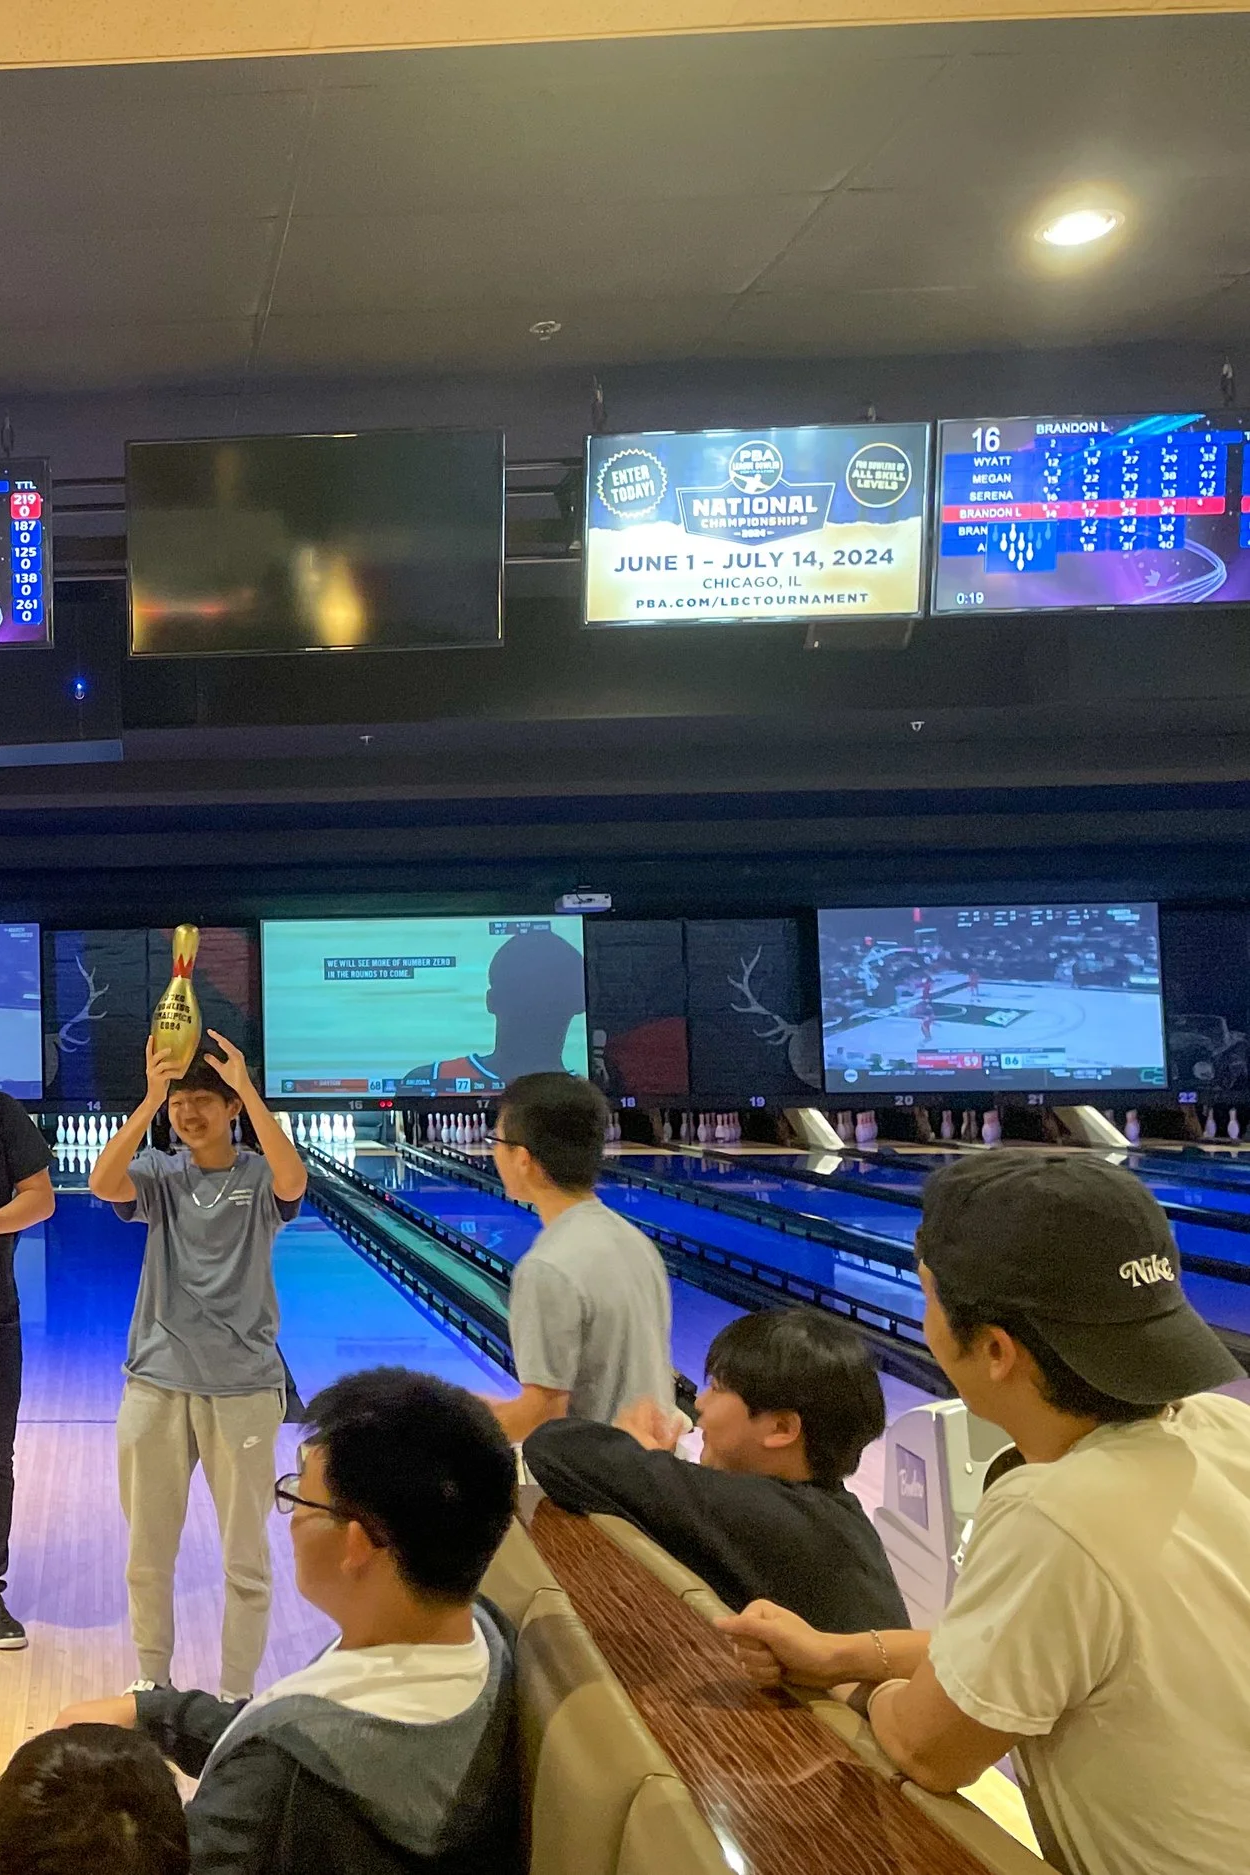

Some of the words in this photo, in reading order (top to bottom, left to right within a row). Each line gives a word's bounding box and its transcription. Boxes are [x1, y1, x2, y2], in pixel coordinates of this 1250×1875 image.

[1036, 423, 1098, 434] BRANDON
[1101, 422, 1108, 432] L
[972, 427, 1000, 453] 16
[1050, 439, 1056, 448] 2
[740, 449, 775, 461] PBA
[974, 456, 1012, 467] WYATT
[612, 465, 649, 487] ENTER
[852, 469, 873, 479] ALL
[875, 470, 906, 482] SKILL
[972, 473, 1011, 484] MEGAN
[1201, 470, 1215, 479] 47
[14, 481, 37, 490] TTL
[857, 479, 898, 490] LEVELS
[611, 480, 655, 504] TODAY!
[969, 490, 1013, 502] SERENA
[13, 494, 36, 505] 219
[19, 505, 30, 517] 0
[692, 495, 818, 517] NATIONAL
[959, 508, 1012, 519] BRANDON
[1015, 507, 1022, 517] L
[14, 521, 36, 531] 187
[700, 515, 808, 529] CHAMPIONSHIPS
[20, 532, 31, 543] 0
[1159, 541, 1174, 549] 40
[15, 547, 37, 557] 125
[20, 558, 31, 570] 0
[614, 555, 678, 572] JUNE
[686, 554, 694, 570] 1
[722, 551, 784, 569] JULY
[793, 551, 824, 570] 14,
[832, 548, 894, 566] 2024
[15, 573, 37, 584] 138
[703, 575, 783, 589] CHICAGO,
[789, 576, 802, 587] IL
[21, 584, 32, 596] 0
[16, 599, 38, 610] 261
[636, 593, 869, 609] PBA.COM/LBCTOURNAMENT
[956, 593, 983, 604] 0:19
[22, 610, 32, 622] 0
[327, 960, 338, 968] WE
[339, 959, 355, 968] WILL
[358, 959, 370, 967] SEE
[372, 959, 390, 967] MORE
[392, 959, 400, 967] OF
[402, 958, 431, 967] NUMBER
[432, 958, 450, 966] ZERO
[327, 970, 335, 978] IN
[337, 970, 349, 978] THE
[351, 970, 378, 978] ROUNDS
[379, 969, 388, 977] TO
[390, 969, 410, 977] COME.
[370, 1081, 381, 1090] 68
[458, 1081, 469, 1089] 77
[87, 1101, 101, 1111] 14
[348, 1100, 363, 1109] 16
[476, 1100, 490, 1108] 17
[621, 1098, 635, 1108] 18
[750, 1097, 765, 1107] 19
[895, 1096, 913, 1106] 20
[1028, 1095, 1043, 1104] 21
[1178, 1092, 1197, 1103] 22
[1119, 1254, 1174, 1287] Nike
